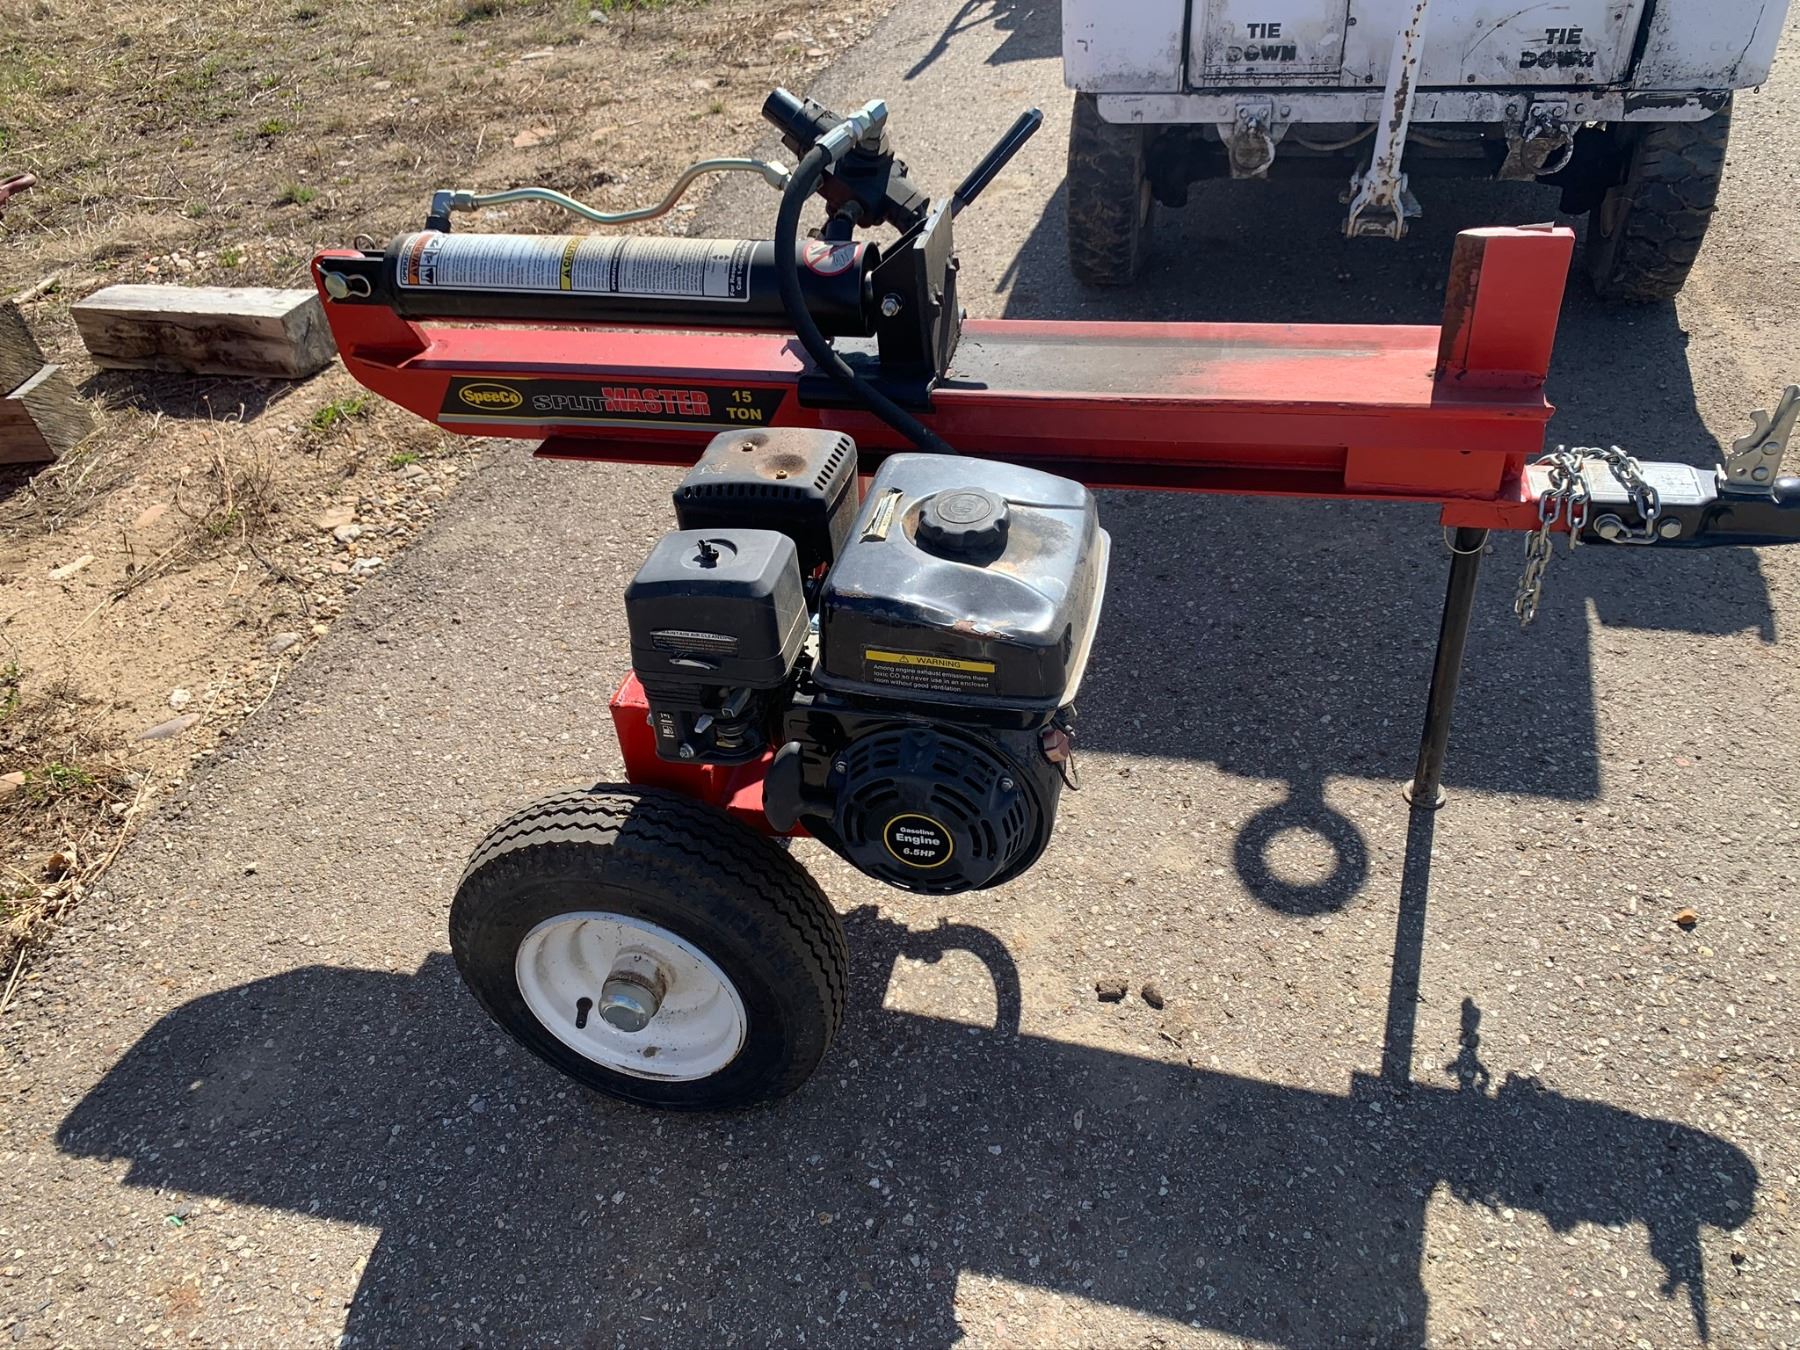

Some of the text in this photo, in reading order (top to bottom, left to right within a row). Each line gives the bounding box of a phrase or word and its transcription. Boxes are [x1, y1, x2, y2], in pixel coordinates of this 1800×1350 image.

[1246, 22, 1282, 39] TIE
[1545, 27, 1584, 45] TIE
[1225, 44, 1297, 63] DOWN
[1519, 50, 1597, 69] DOWN
[464, 390, 519, 404] SpeeCo
[731, 390, 752, 403] 15
[725, 407, 762, 421] TON
[873, 664, 895, 672] Among
[916, 657, 961, 668] WARNING
[890, 679, 913, 687] without
[930, 683, 961, 692] ventilation
[960, 680, 989, 688] enclosed
[900, 826, 935, 836] Gasoline
[895, 832, 941, 846] Engine
[902, 847, 936, 857] 6.5HP
